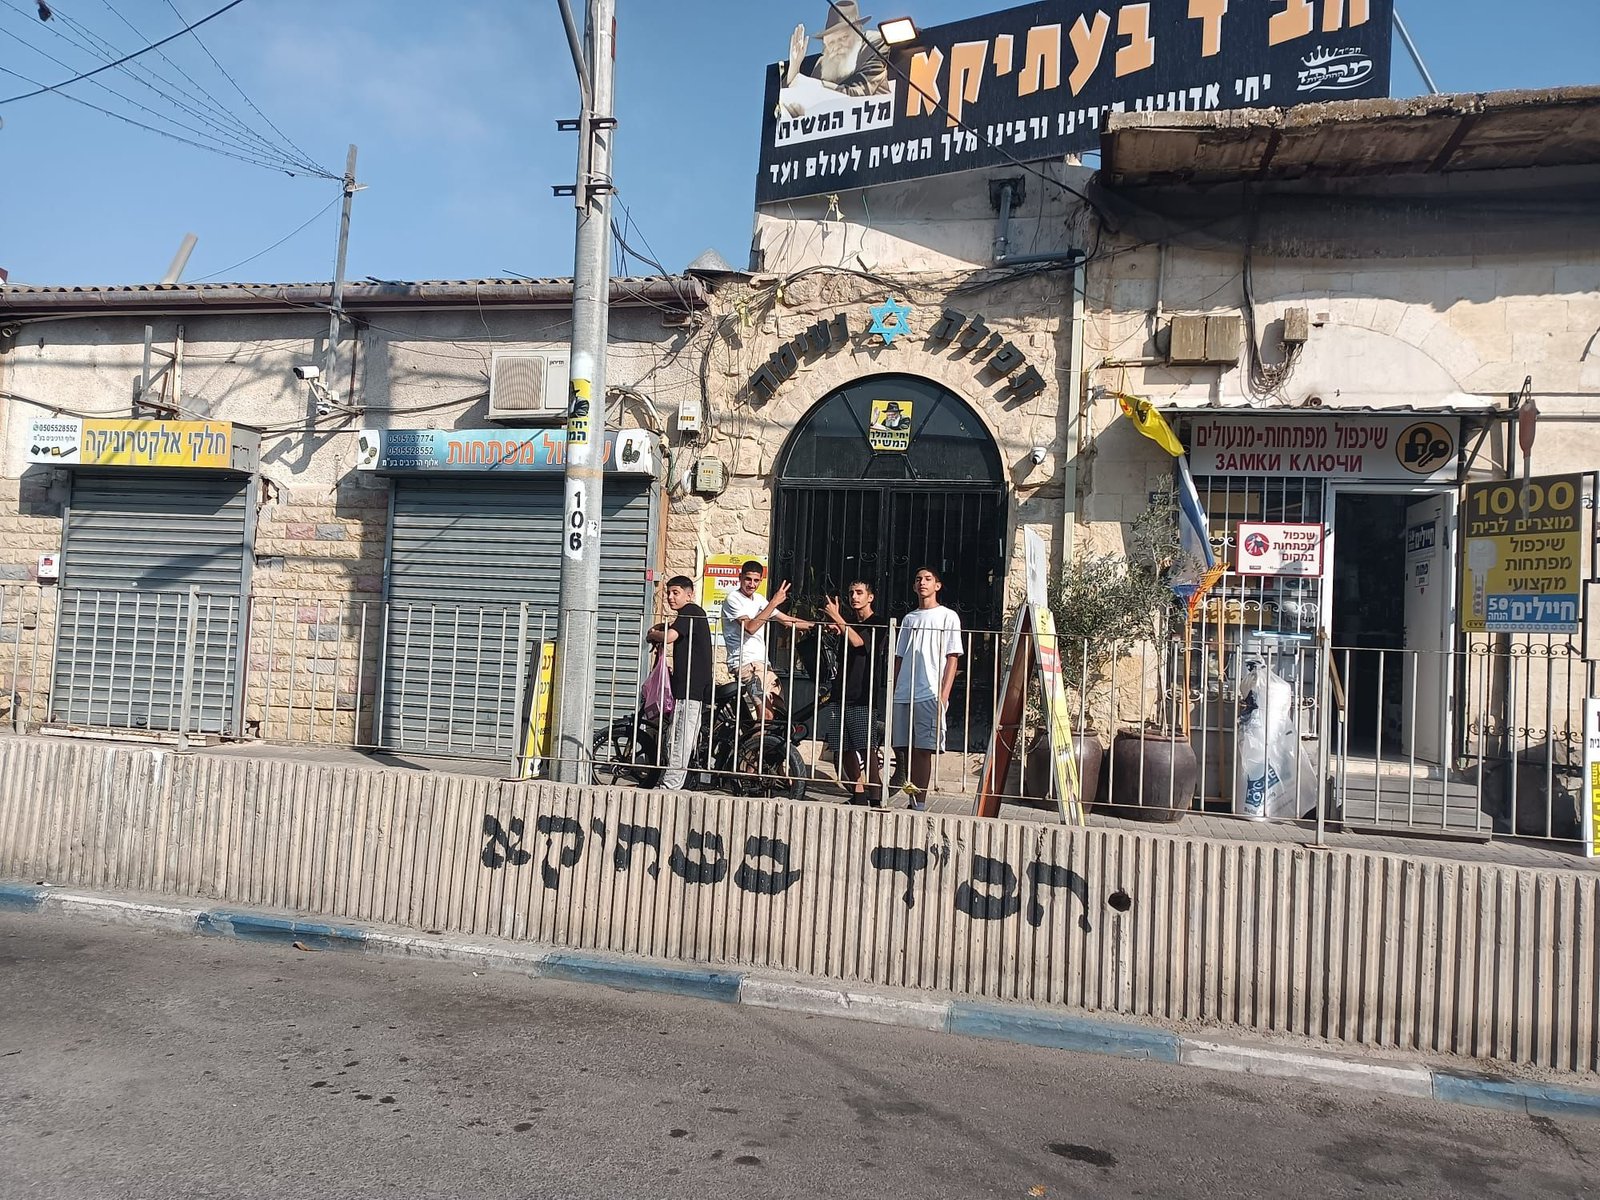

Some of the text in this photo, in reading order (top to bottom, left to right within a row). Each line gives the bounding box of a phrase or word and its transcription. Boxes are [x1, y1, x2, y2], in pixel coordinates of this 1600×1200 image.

[905, 3, 1156, 128] בעתיקא
[1234, 73, 1271, 102] יחי
[778, 100, 891, 140] מלך המשיח
[987, 116, 1049, 148] ורבינו
[869, 137, 932, 169] המשיח
[941, 127, 978, 162] מלך
[805, 144, 862, 177] לעולם
[769, 159, 799, 186] ועד
[932, 307, 1047, 396] תפילה
[571, 421, 588, 430] יחי
[870, 431, 893, 439] המלך
[84, 423, 227, 462] חלקי אלקטרוניקה
[388, 434, 434, 443] 0505737774
[870, 439, 908, 448] המשיח
[1335, 422, 1388, 450] שיכפול
[388, 446, 434, 455] 0505528552
[446, 439, 535, 465] מפתחות
[424, 458, 439, 468] אלוף
[1215, 453, 1363, 473] ЗАМКИ КЛЮЧИ
[1473, 481, 1575, 516] 1000
[569, 491, 584, 551] 106
[1471, 515, 1574, 534] מוצרים לבית
[1283, 530, 1316, 540] שכפול
[1510, 537, 1566, 553] שיכפול
[1272, 542, 1315, 551] מפתחות
[1282, 553, 1315, 563] במקום
[1504, 555, 1573, 571] מפתחות
[718, 579, 740, 587] איקה
[1508, 576, 1567, 594] מקצועי
[1487, 612, 1508, 621] הנחה
[1511, 596, 1576, 621] חיילים
